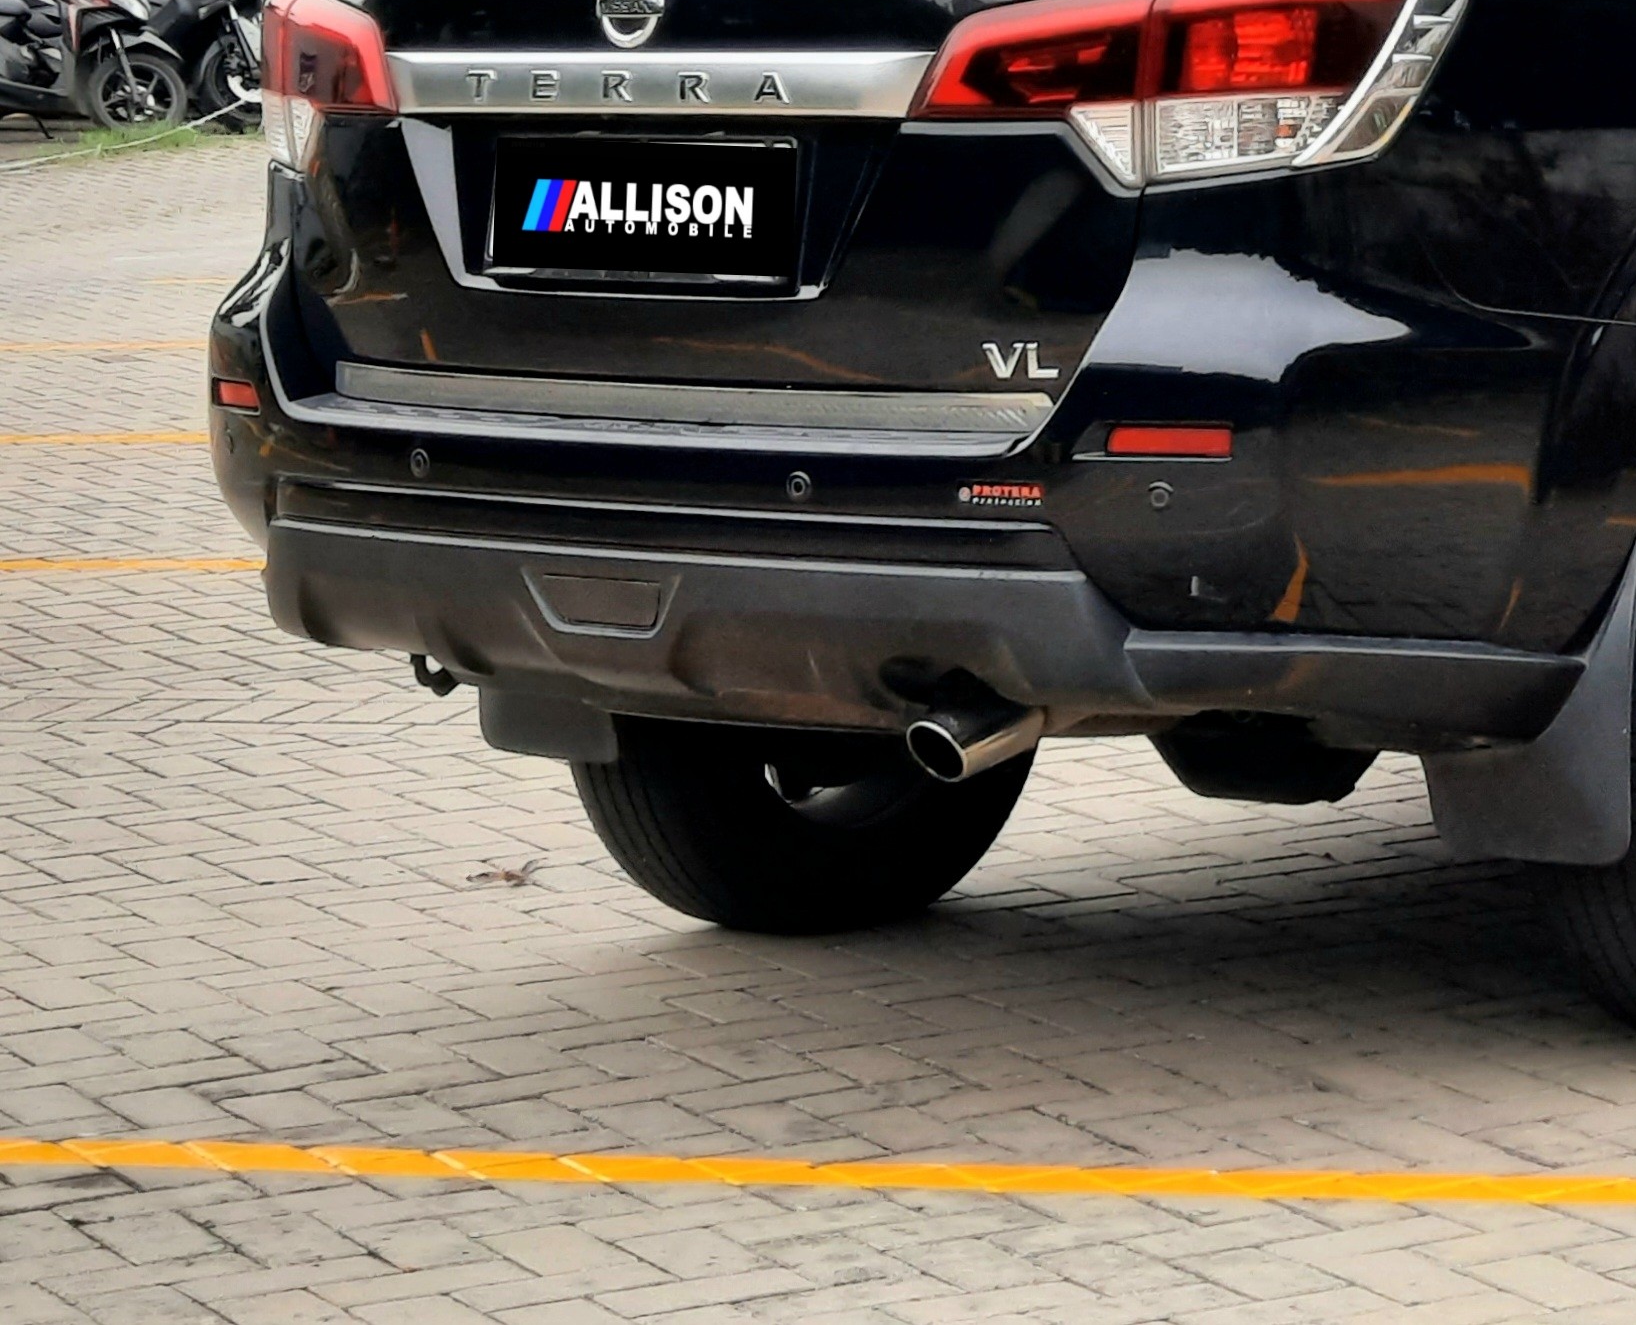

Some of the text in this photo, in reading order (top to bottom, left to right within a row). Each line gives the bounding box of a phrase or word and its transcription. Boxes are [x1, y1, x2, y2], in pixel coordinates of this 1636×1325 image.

[466, 69, 791, 104] TERRA
[982, 342, 1059, 379] VL
[972, 484, 1041, 497] PROTERA
